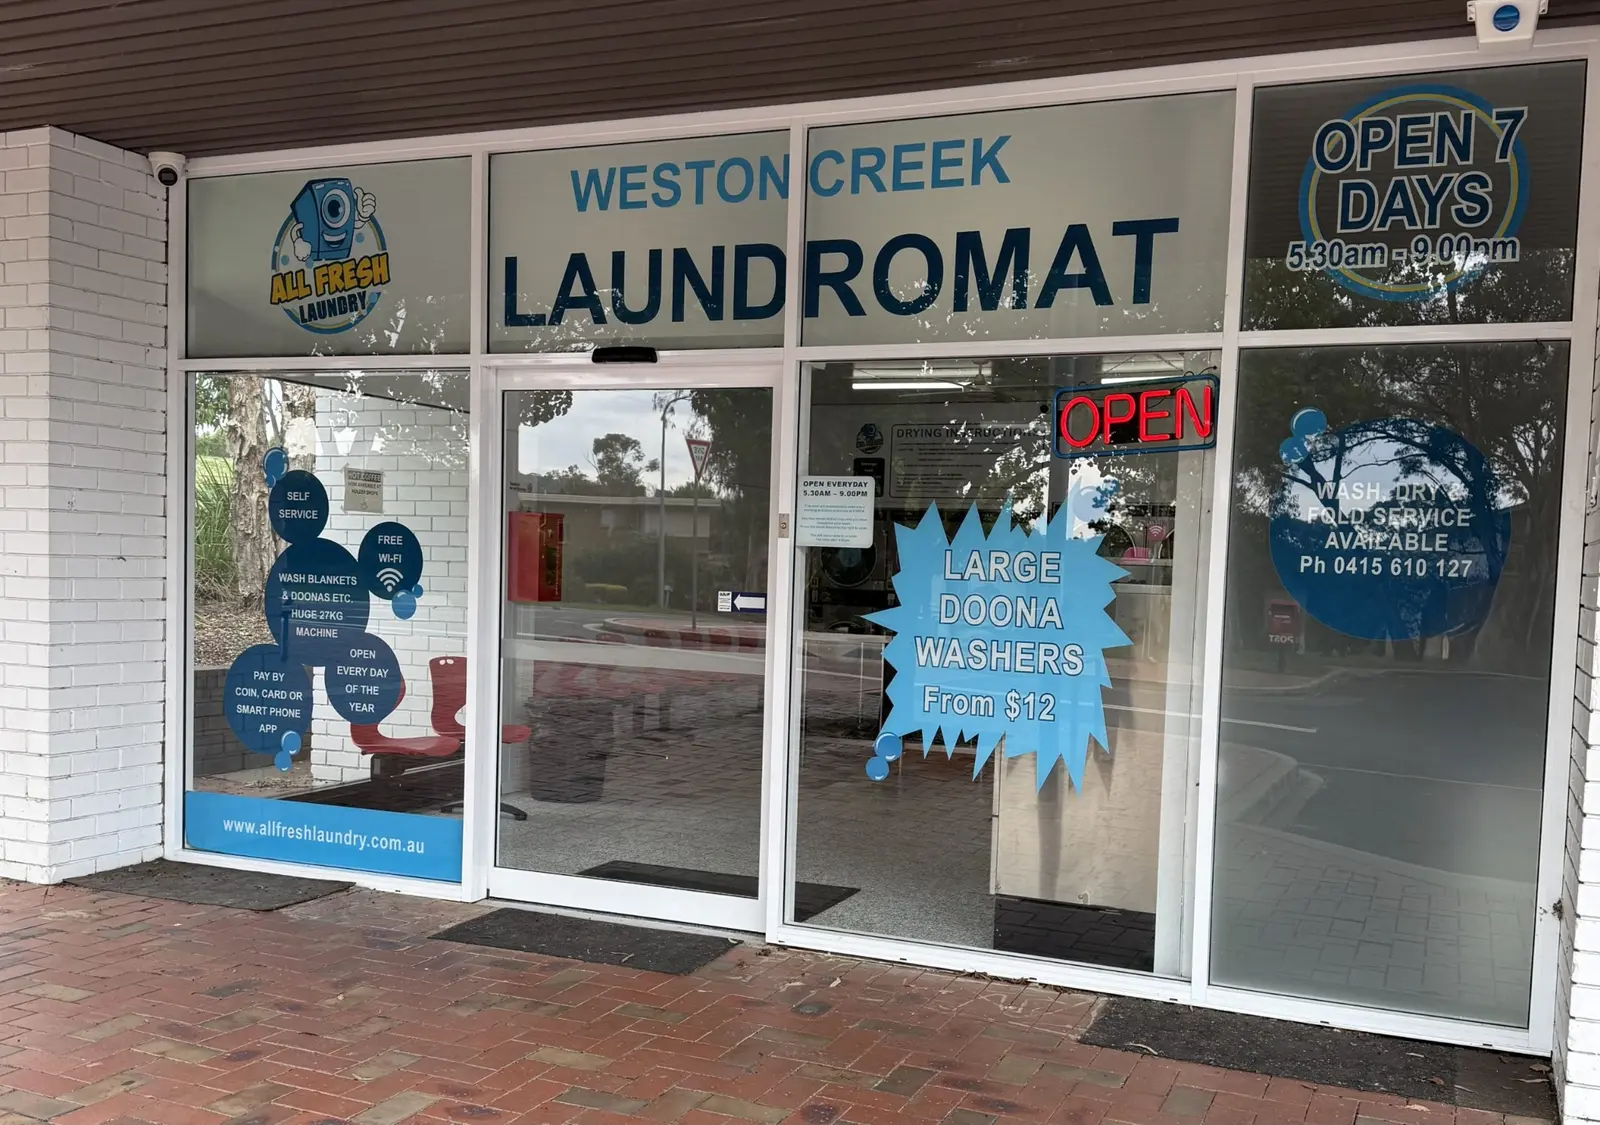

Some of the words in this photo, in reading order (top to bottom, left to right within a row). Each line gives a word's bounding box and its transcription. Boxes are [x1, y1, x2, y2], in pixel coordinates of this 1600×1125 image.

[1312, 110, 1476, 174] OPEN
[1492, 106, 1528, 163] 7
[570, 154, 790, 212] WESTON
[809, 135, 1012, 198] CREEK
[1337, 170, 1493, 234] DAYS
[1286, 238, 1388, 272] 5.30am
[1410, 232, 1520, 269] 9.00pm
[270, 268, 312, 305] ALL
[314, 252, 391, 297] FRESH
[504, 217, 1180, 327] LAUNDROMAT
[299, 290, 368, 324] LAUNDRY
[1060, 384, 1212, 448] OPEN
[896, 428, 942, 438] DRYING
[287, 491, 310, 502] SELF
[1396, 482, 1443, 500] DRY
[279, 508, 318, 520] SERVICE
[1306, 506, 1365, 526] FOLD
[1373, 508, 1471, 528] SERVICE
[378, 535, 403, 546] FREE
[1324, 533, 1449, 552] AVAILABLE
[378, 553, 402, 564] WI-FI
[944, 549, 1062, 584] LARGE
[1300, 556, 1326, 574] Ph
[1334, 556, 1382, 576] 0415
[1390, 558, 1427, 577] 610
[1436, 560, 1473, 578] 127
[279, 573, 306, 584] WASH
[308, 574, 358, 586] BLANKETS
[282, 591, 288, 600] &
[290, 591, 330, 602] DOONAS
[332, 592, 354, 604] ETC.
[291, 608, 317, 620] HUGE
[319, 609, 344, 620] 27KG
[939, 593, 1065, 630] DOONA
[296, 627, 338, 638] MACHINE
[350, 648, 376, 659] OPEN
[914, 636, 1085, 676] WASHERS
[254, 671, 270, 682] PAY
[272, 672, 285, 682] BY
[336, 666, 368, 676] EVERY
[370, 668, 388, 678] DAY
[235, 687, 260, 698] COIN,
[261, 688, 287, 700] CARD
[288, 690, 303, 701] OR
[345, 684, 358, 694] OF
[360, 686, 380, 696] THE
[236, 704, 268, 715] SMART
[269, 706, 301, 718] PHONE
[348, 702, 375, 712] YEAR
[922, 685, 994, 718] From
[1004, 689, 1056, 722] $12
[258, 724, 277, 733] APP
[223, 819, 425, 854] www.allfreshlaundry.com.au
